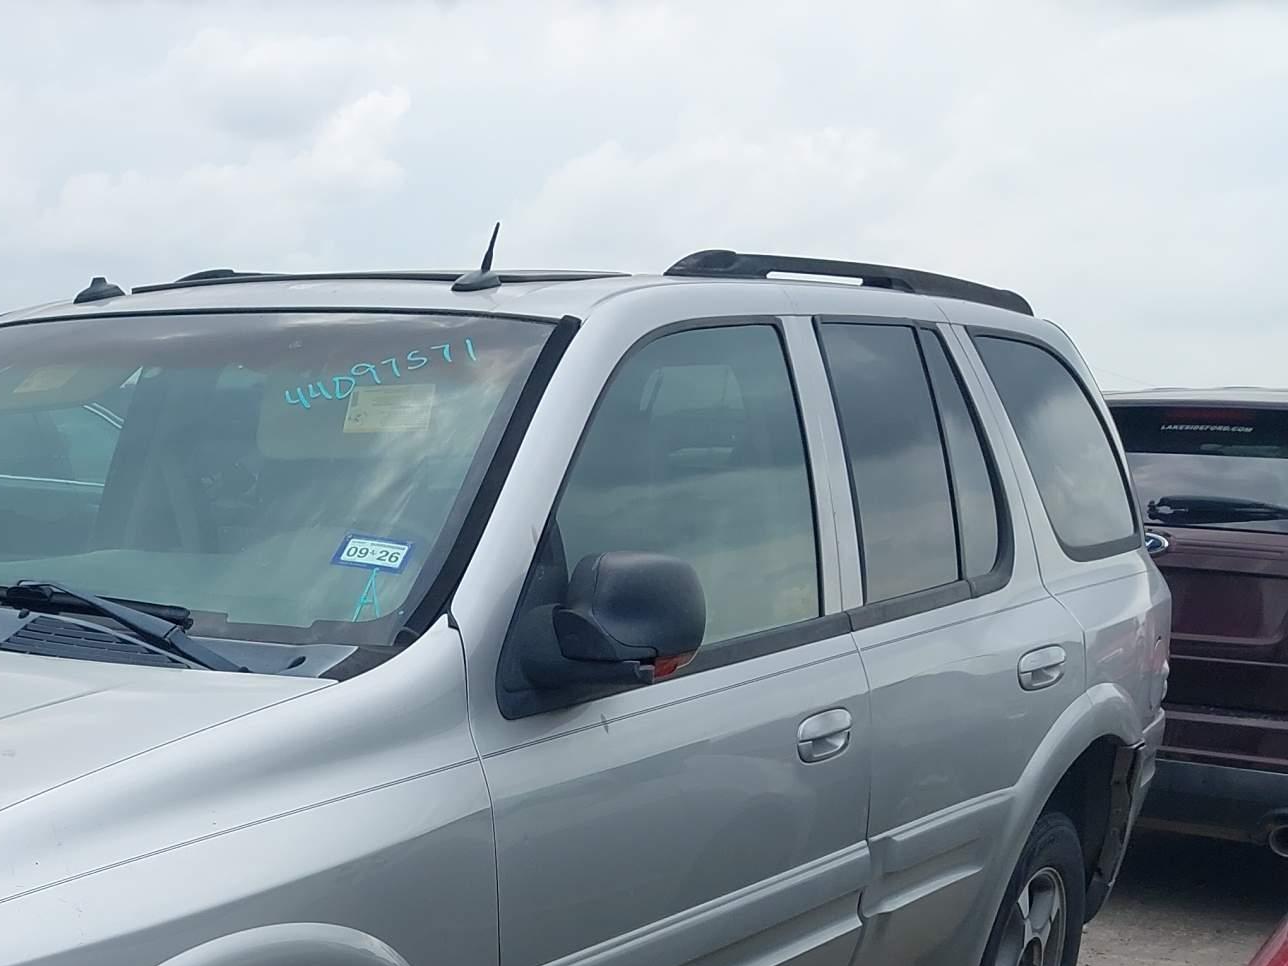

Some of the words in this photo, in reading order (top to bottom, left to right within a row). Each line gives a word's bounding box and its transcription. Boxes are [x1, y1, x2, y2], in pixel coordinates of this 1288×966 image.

[284, 338, 477, 409] 44097571
[346, 546, 370, 559] 09
[376, 550, 401, 564] 26
